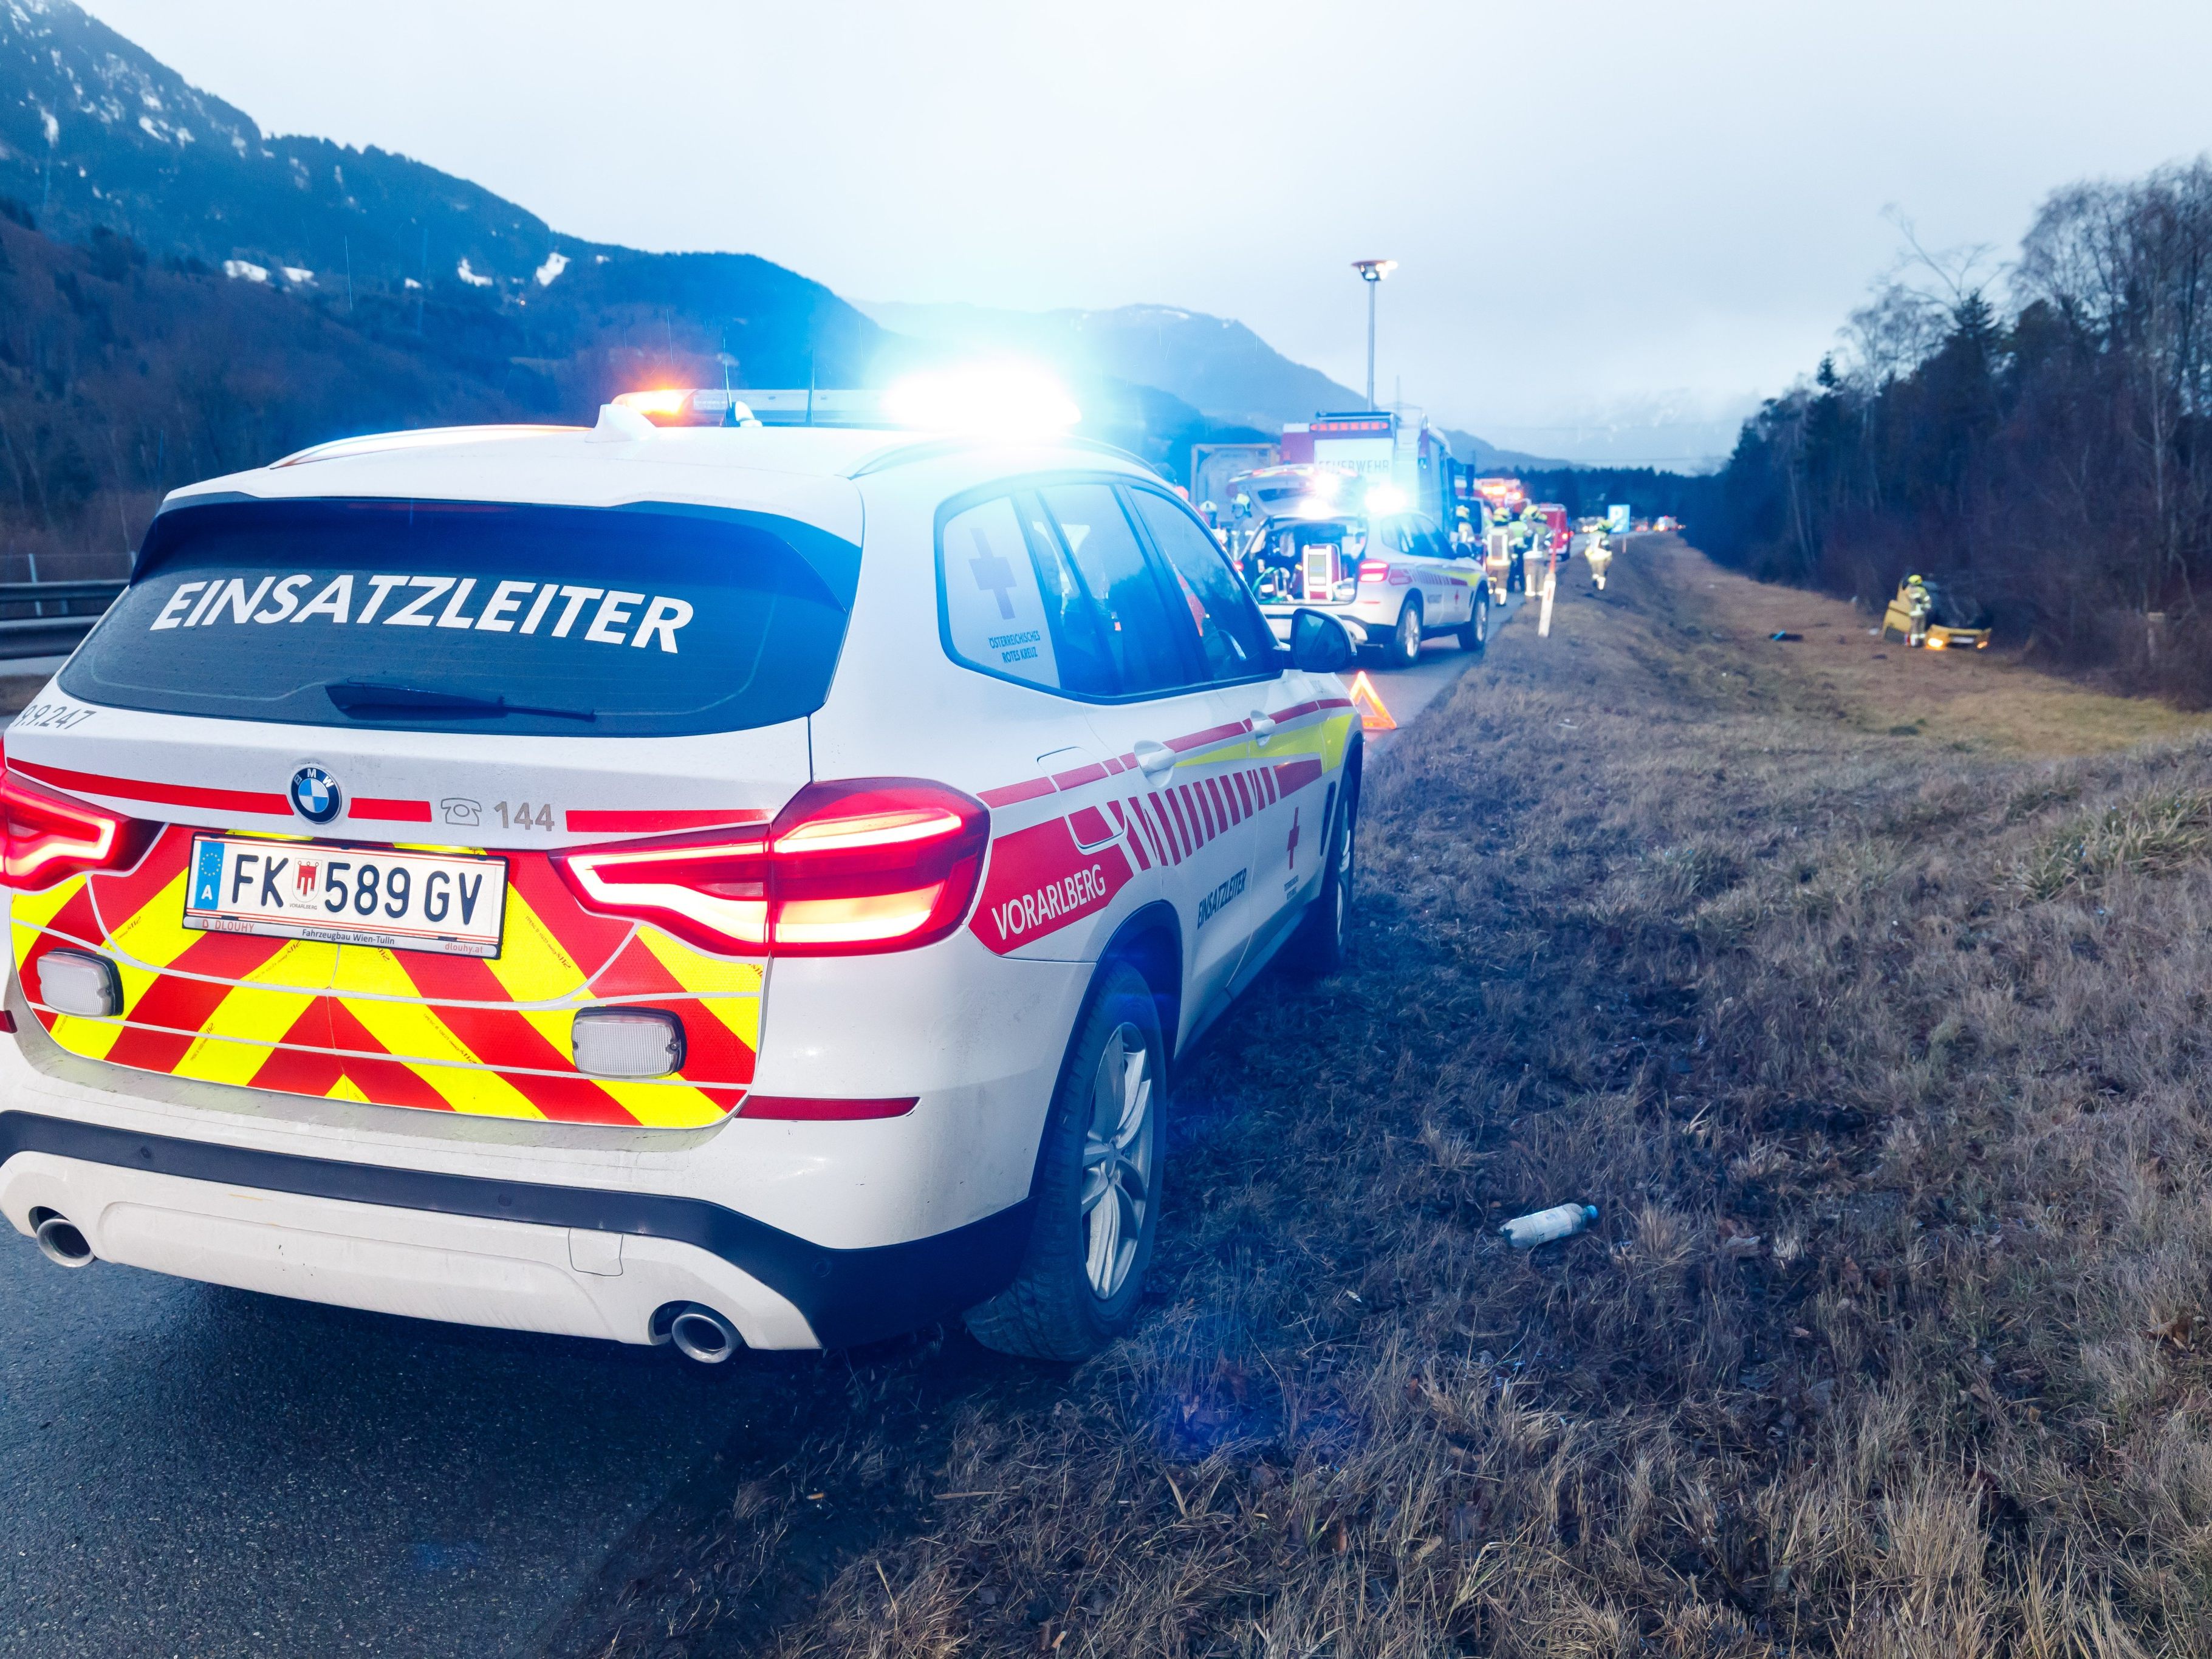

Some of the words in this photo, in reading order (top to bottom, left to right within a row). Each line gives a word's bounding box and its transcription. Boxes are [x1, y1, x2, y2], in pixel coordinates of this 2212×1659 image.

[149, 574, 694, 654] EINSATZLEITER
[988, 630, 1041, 649] ÖSTERREICHISCHES
[1002, 650, 1021, 663] ROTES
[1020, 646, 1038, 660] KREUZ
[293, 768, 335, 788] BMW
[493, 801, 555, 832] 144
[201, 884, 213, 900] A
[232, 854, 289, 908] FK
[324, 861, 411, 918] 589
[424, 871, 482, 925] GV
[1197, 867, 1247, 930] EINSATZLEITER
[991, 864, 1106, 940] VORARLBERG
[214, 920, 255, 932] DLOUHY
[302, 928, 351, 941] Fahrzeugbau
[353, 934, 395, 945] Wien-Tulln
[445, 942, 483, 954] dlouhy.at
